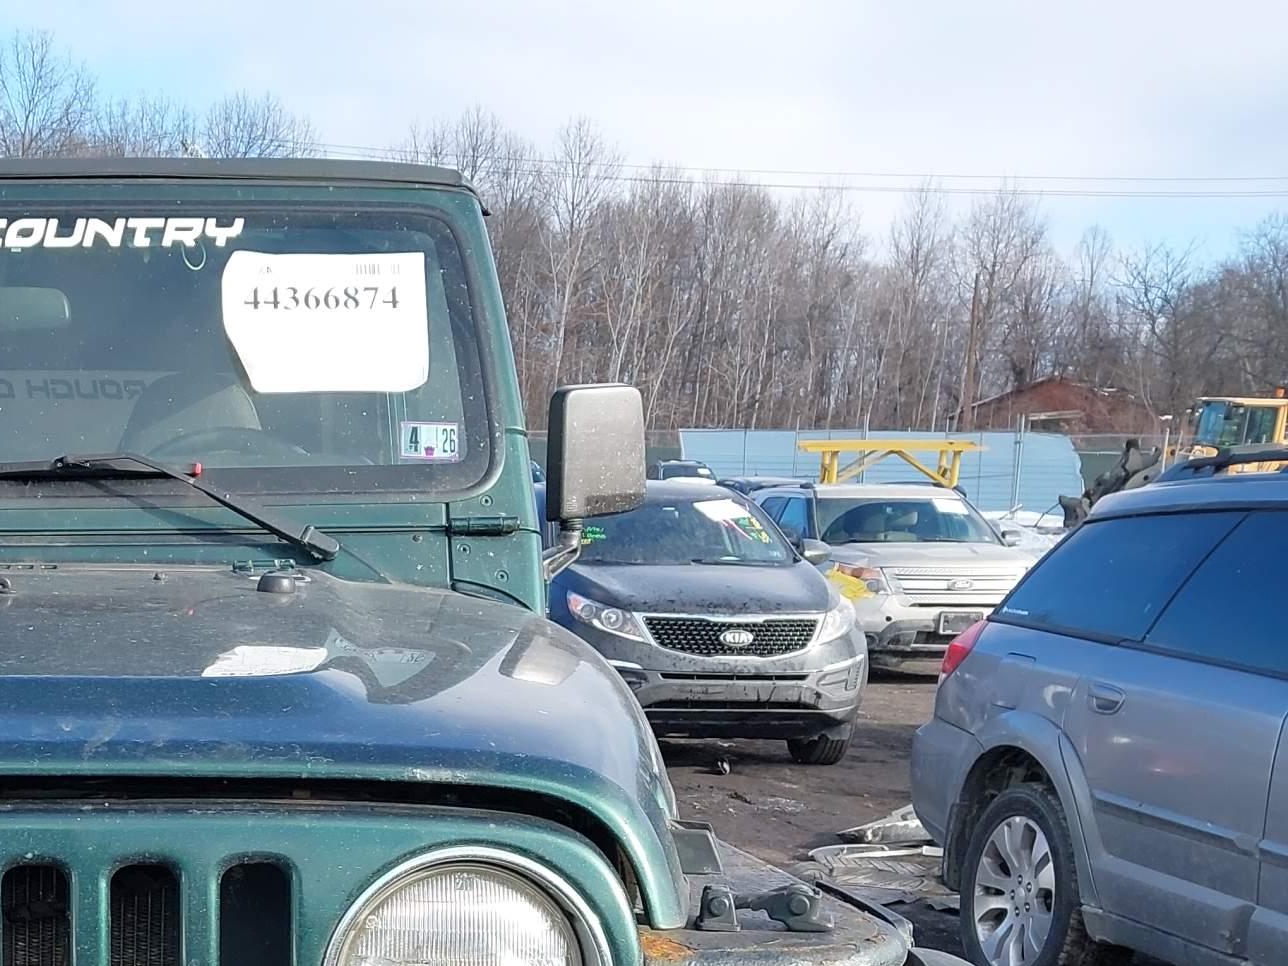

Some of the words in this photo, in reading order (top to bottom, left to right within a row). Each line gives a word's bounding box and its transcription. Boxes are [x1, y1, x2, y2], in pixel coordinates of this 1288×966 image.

[243, 286, 400, 310] 44366874
[442, 428, 456, 453] 26
[725, 631, 752, 643] KIA
